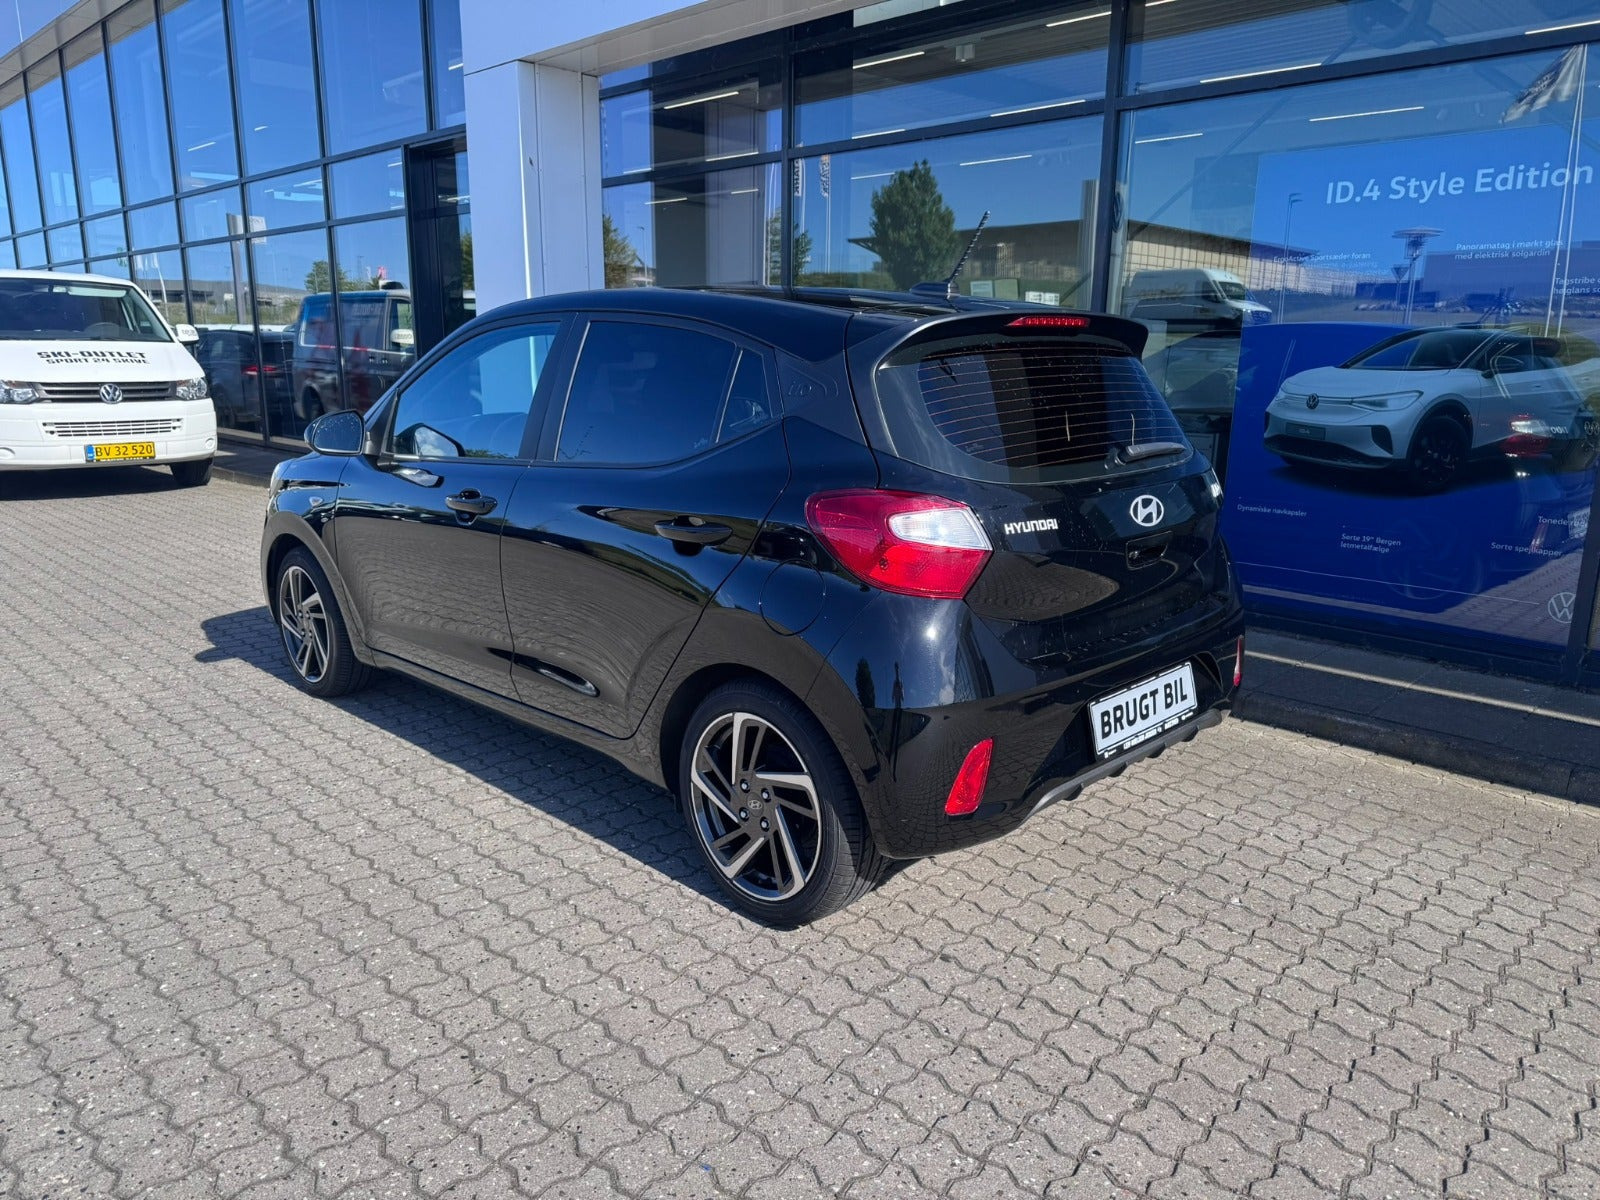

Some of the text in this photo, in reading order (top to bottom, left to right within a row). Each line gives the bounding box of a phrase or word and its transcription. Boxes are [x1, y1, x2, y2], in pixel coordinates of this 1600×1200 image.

[1326, 162, 1593, 204] ID.4 Style Edition
[1456, 242, 1510, 251] Panoramatag
[1455, 249, 1551, 260] med elektrisk solgardin
[37, 350, 146, 359] SKI-OUTLET
[95, 444, 153, 457] BV 32 520
[1538, 515, 1568, 526] Tonede
[1004, 518, 1058, 535] HYUNDAI
[1341, 532, 1361, 541] Sorte
[1491, 541, 1513, 551] Sorte
[1100, 688, 1159, 739] BRUGT
[1164, 677, 1188, 710] BIL
